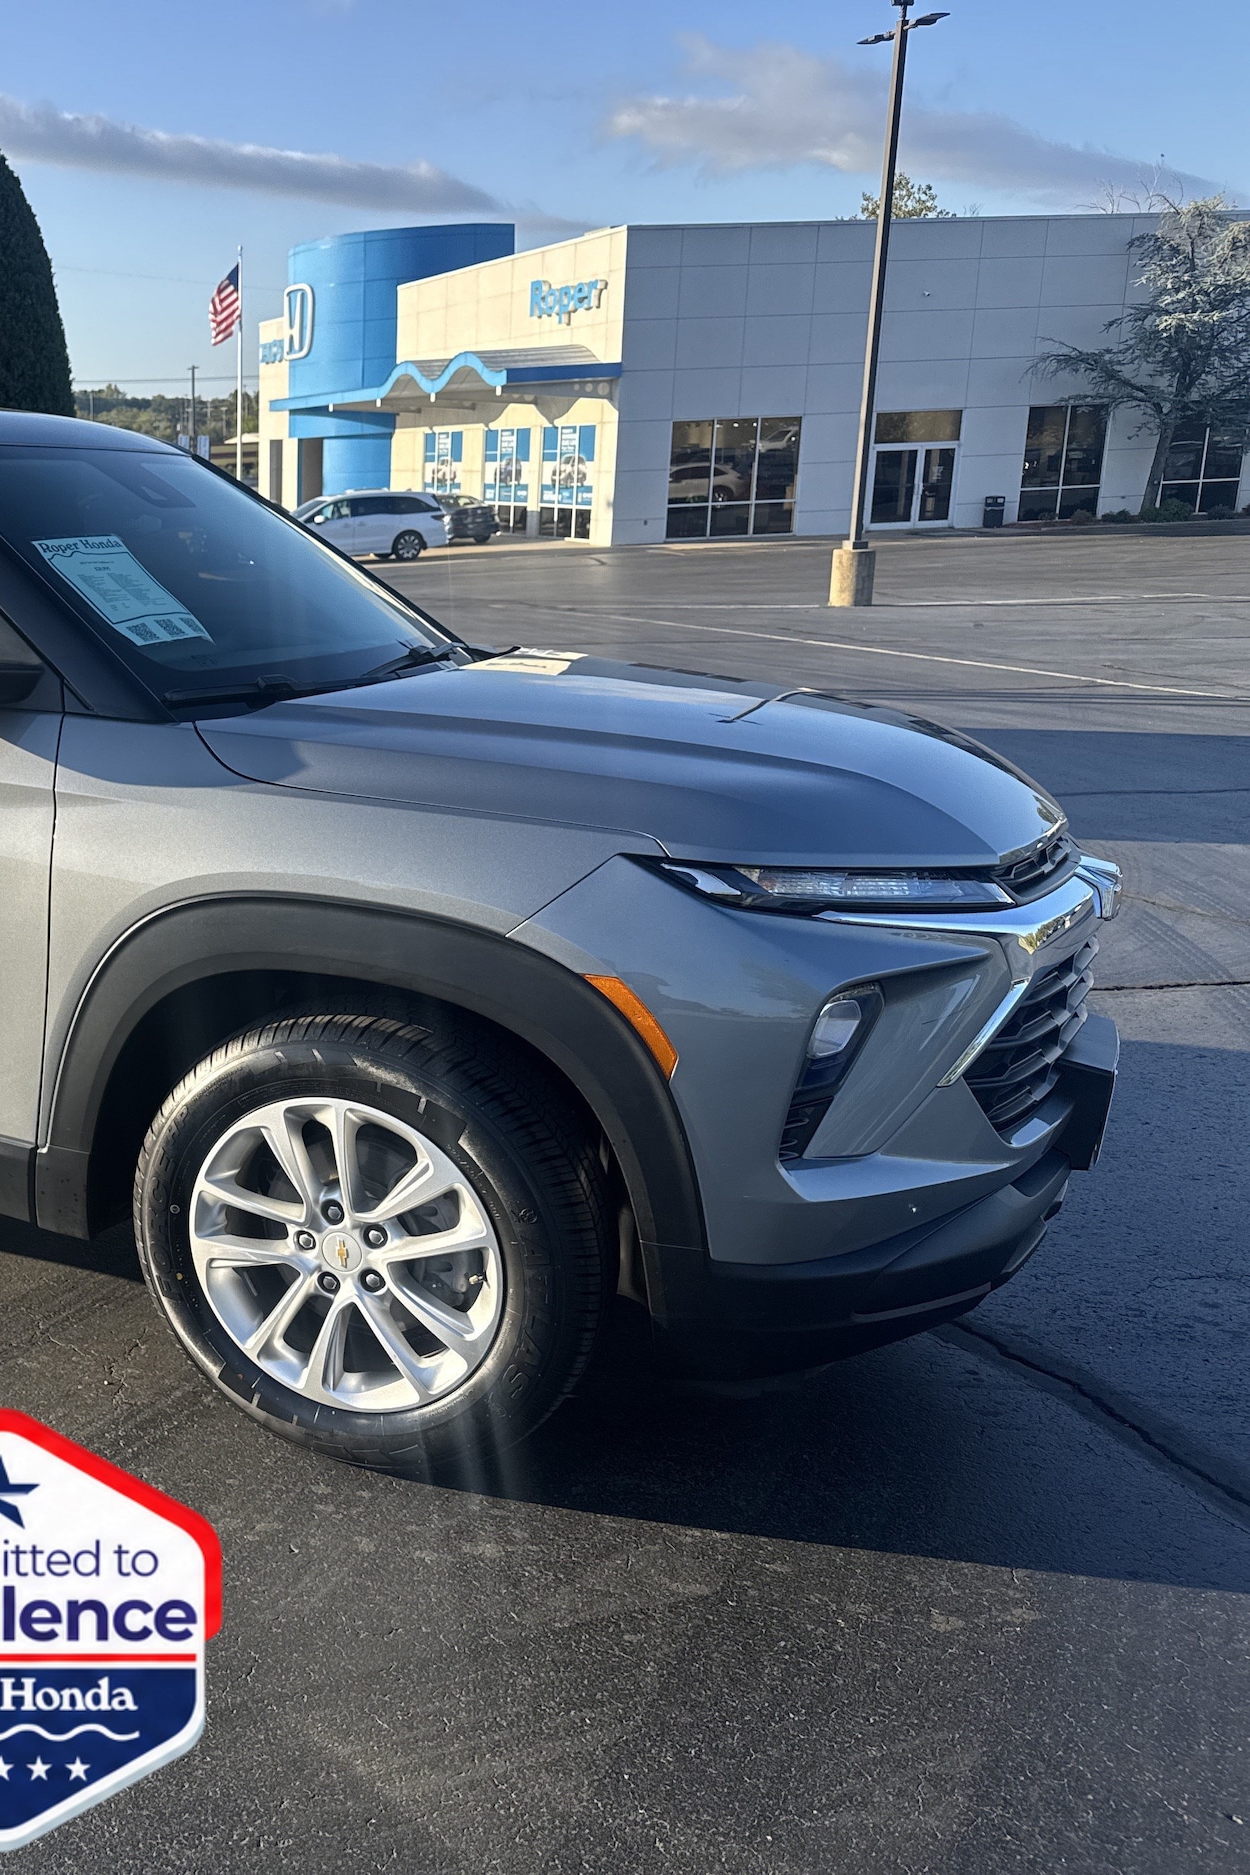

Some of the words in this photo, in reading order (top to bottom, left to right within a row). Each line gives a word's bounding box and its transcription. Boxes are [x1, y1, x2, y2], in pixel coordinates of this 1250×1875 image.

[529, 279, 607, 325] Roper
[38, 540, 79, 554] Roper
[79, 537, 123, 550] Honda
